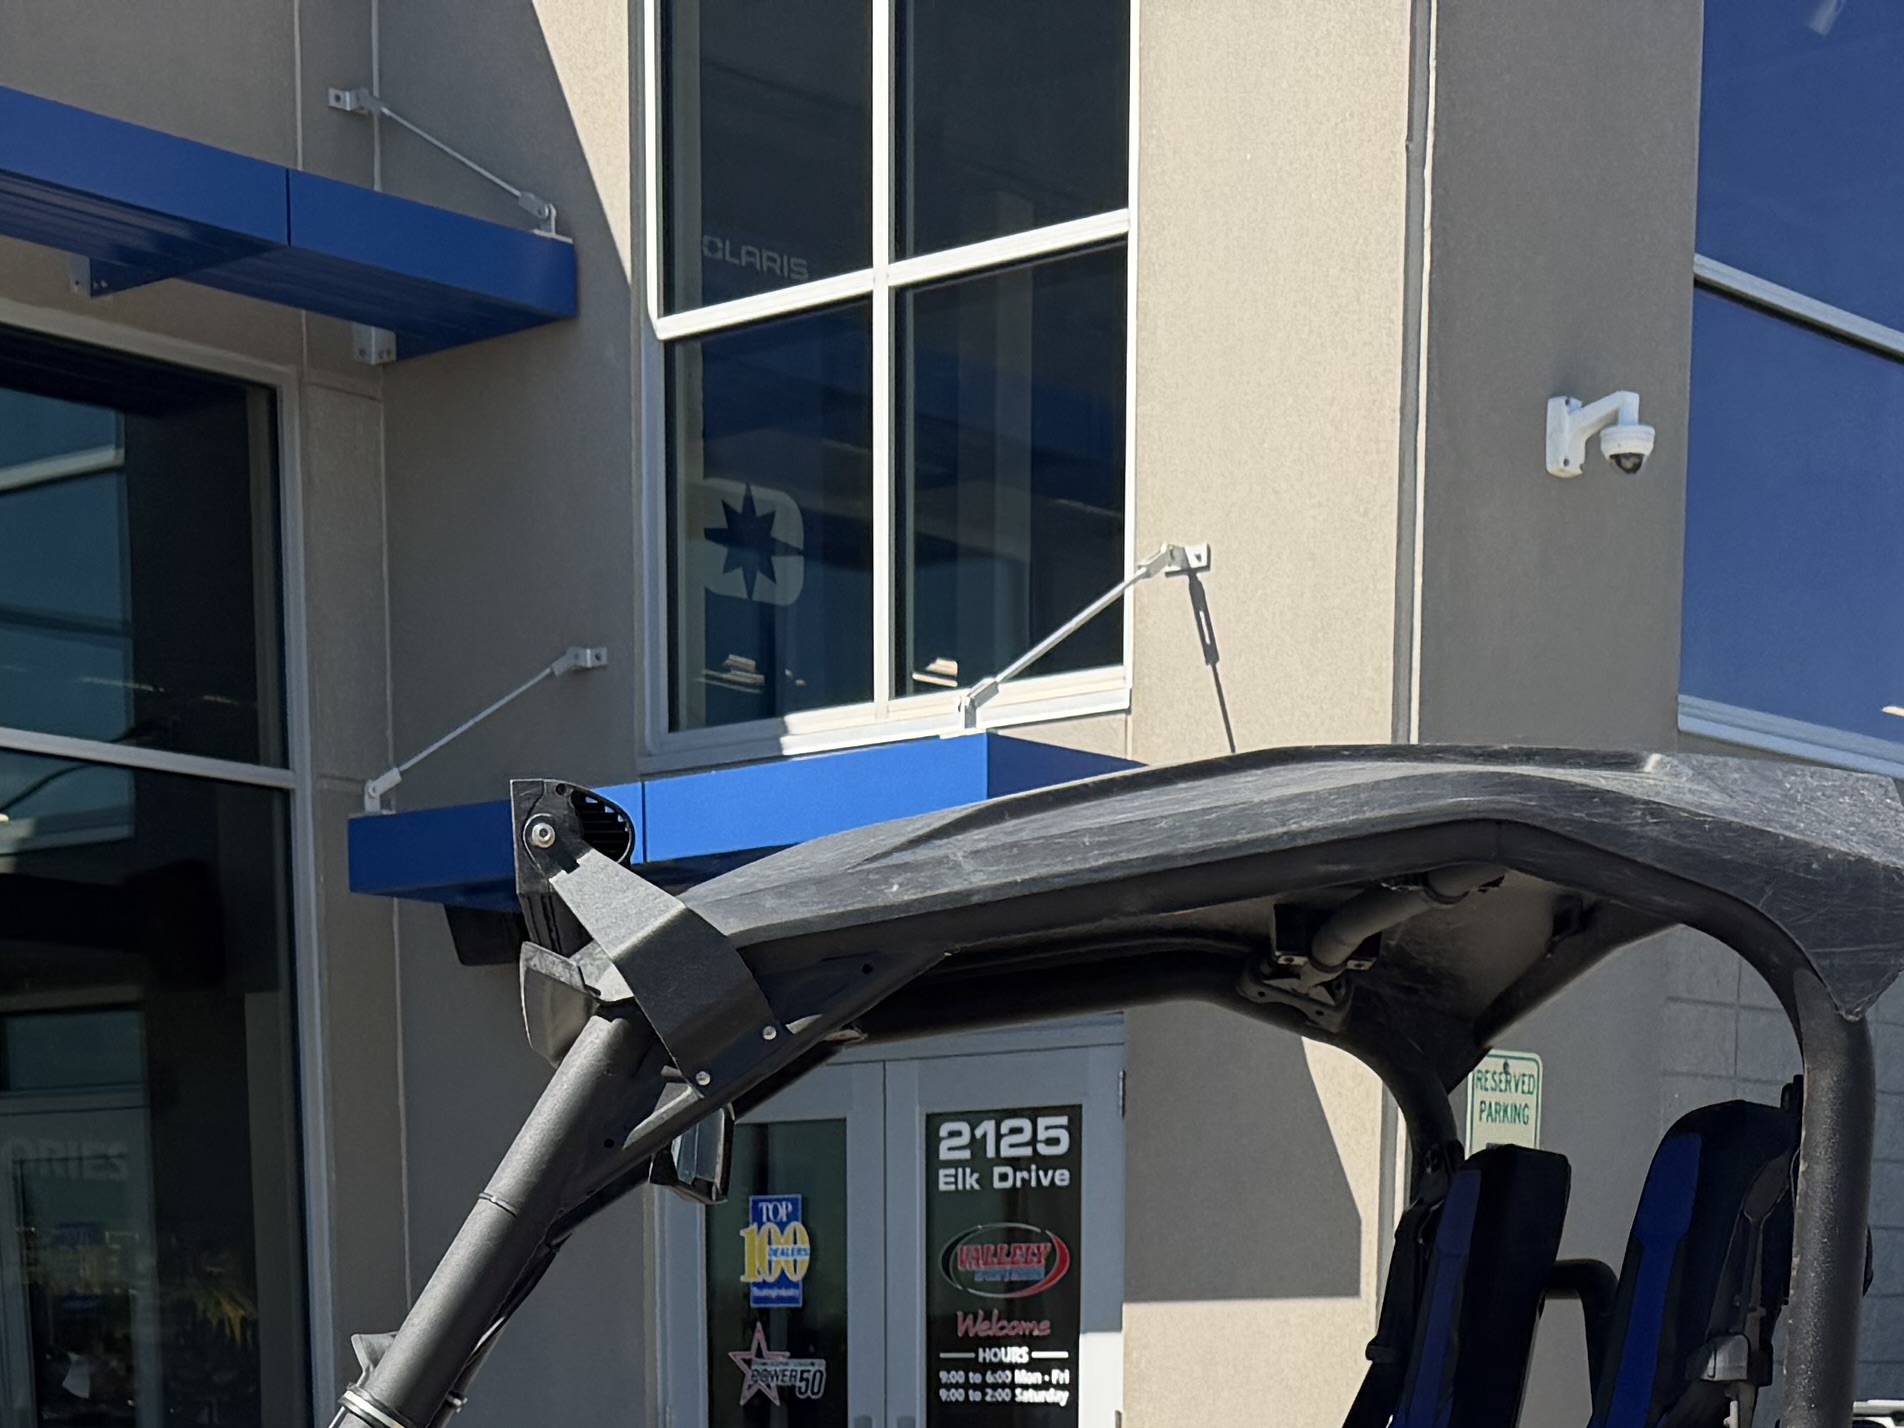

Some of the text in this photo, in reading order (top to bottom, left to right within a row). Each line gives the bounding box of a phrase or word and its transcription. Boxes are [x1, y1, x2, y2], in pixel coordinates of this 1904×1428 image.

[701, 234, 809, 280] OLARIS
[1476, 1069, 1536, 1095] RESERVED
[1479, 1100, 1530, 1125] PARKING
[939, 1115, 1070, 1160] 2125
[938, 1164, 1070, 1191] Elk Drive
[758, 1201, 793, 1222] TOP
[740, 1221, 810, 1283] 100
[957, 1309, 1051, 1337] Welcome
[978, 1346, 1029, 1363] HOURS
[797, 1369, 824, 1396] 50
[968, 1371, 982, 1384] to
[968, 1389, 982, 1402] to
[985, 1388, 1012, 1402] 2:00
[1015, 1387, 1069, 1407] Saturday
